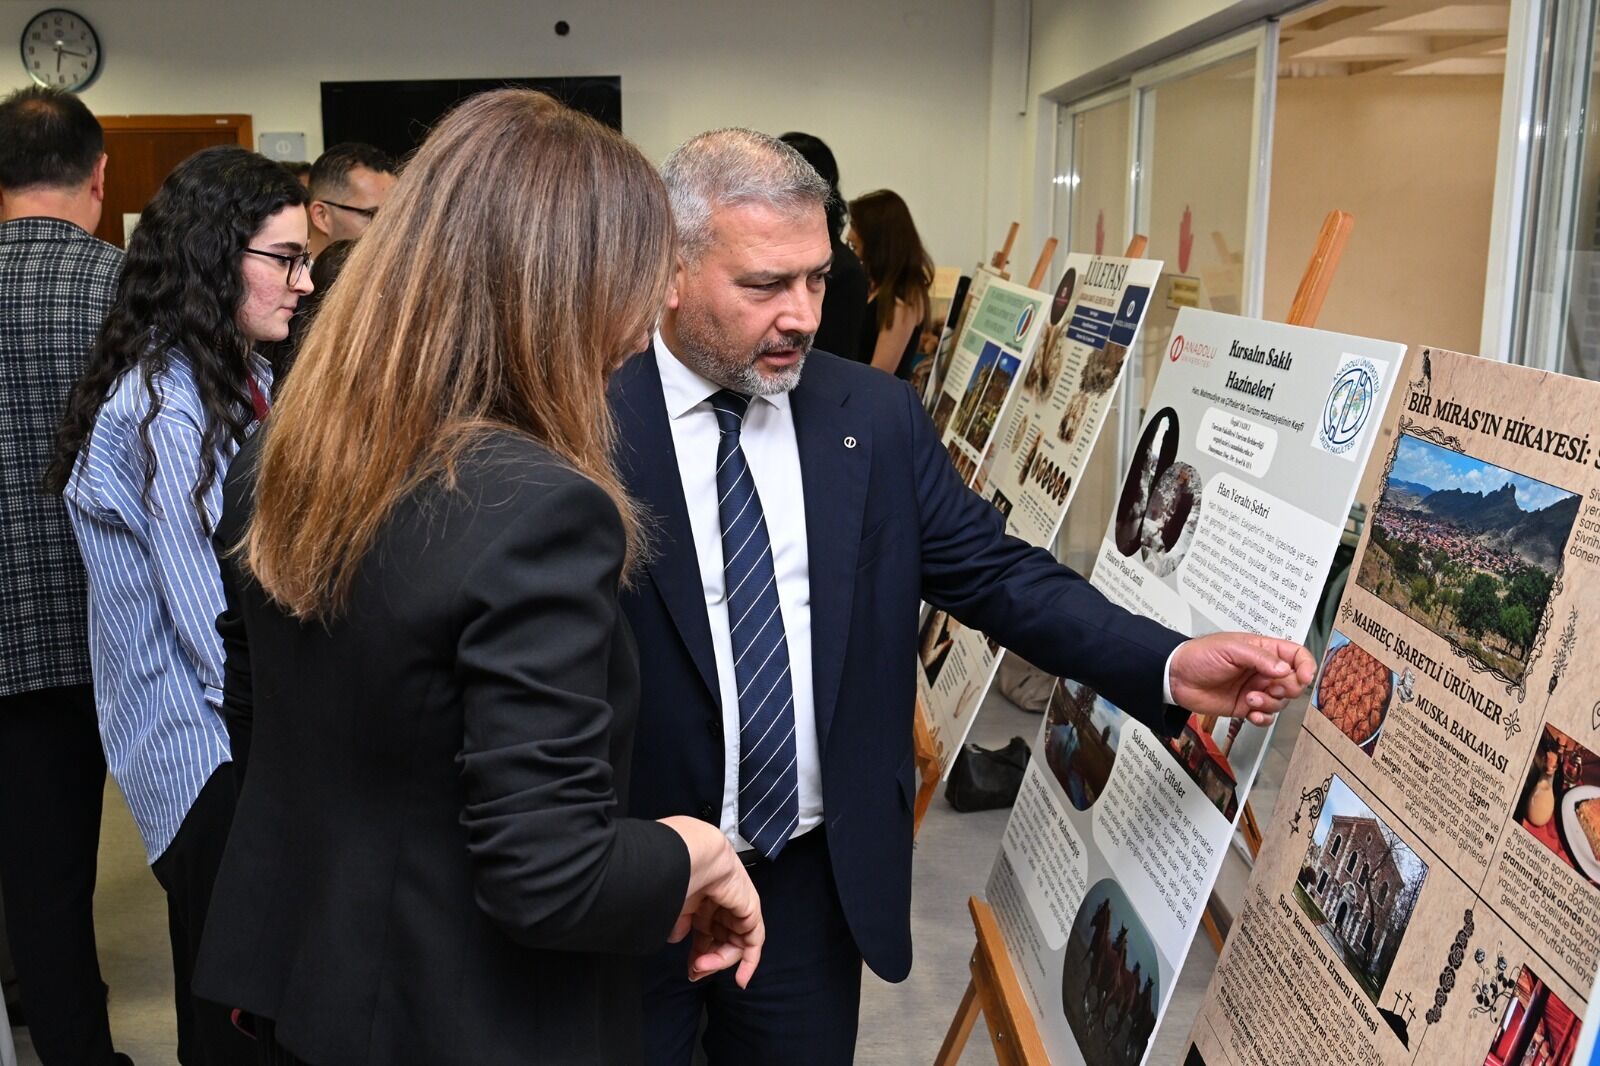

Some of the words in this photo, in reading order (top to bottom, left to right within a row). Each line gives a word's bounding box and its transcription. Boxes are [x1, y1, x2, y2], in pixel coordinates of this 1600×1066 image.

[1226, 371, 1275, 400] Hazineleri
[1229, 340, 1265, 364] Kırsalın
[1266, 348, 1292, 370] Saklı
[1408, 390, 1432, 416] BİR
[1433, 397, 1502, 436] MİRAS'IN
[1502, 417, 1591, 464] HİKAYESİ:
[1217, 482, 1230, 498] Han
[1231, 489, 1251, 509] Yeraltı
[1251, 500, 1270, 518] Şehri
[1282, 578, 1297, 590] edilen
[1300, 588, 1307, 598] bu
[1296, 552, 1306, 560] yer
[1306, 556, 1318, 567] alan
[1305, 573, 1313, 582] bir
[1279, 612, 1285, 620] ve
[1284, 599, 1302, 611] yaşam
[1352, 609, 1394, 651] MAHREÇ
[1393, 634, 1443, 682] İŞARETLİ
[1443, 668, 1502, 724] ÜRÜNLER
[1132, 729, 1162, 771] Sakaryabaşı
[1164, 768, 1185, 798] Çifteler
[1416, 694, 1448, 729] MUSKA
[1450, 720, 1508, 773] BAKLAVASI
[1420, 721, 1439, 741] Muska
[1440, 736, 1469, 765] Baklavası,
[1469, 761, 1505, 794] Eskişehir'in
[1381, 753, 1401, 775] belirgin
[1424, 791, 1458, 827] Sivrihisar'da
[1459, 822, 1483, 848] özellikle
[1395, 728, 1423, 754] geleneksel
[1423, 750, 1431, 761] bir
[1432, 757, 1450, 778] tatlıdır.
[1469, 787, 1489, 810] üçgen
[1402, 760, 1413, 772] onu
[1413, 768, 1429, 786] klasik
[1429, 782, 1463, 817] baklavadan
[1464, 814, 1484, 835] ayıran
[1485, 832, 1494, 844] en
[1408, 750, 1432, 773] "muska"
[1431, 773, 1478, 815] görünümünden
[1479, 812, 1490, 824] alır
[1491, 822, 1499, 833] ve
[1448, 759, 1470, 780] coğrafi
[1470, 777, 1488, 795] işaret
[1489, 792, 1507, 813] almış
[1405, 802, 1419, 819] sıkça
[1419, 815, 1437, 837] yapılır.
[1406, 790, 1437, 822] düğünlerde
[1438, 818, 1445, 829] ve
[1446, 825, 1459, 840] özel
[1458, 838, 1487, 867] günlerde
[1503, 852, 1532, 882] oranının
[1533, 877, 1556, 902] düşük
[1557, 899, 1584, 927] olması
[1506, 837, 1515, 851] Bu
[1516, 848, 1525, 860] da
[1526, 855, 1548, 880] tatlıya
[1549, 874, 1567, 896] hem
[1568, 890, 1590, 917] doğal
[1512, 828, 1550, 866] Pişirildikten
[1551, 863, 1573, 885] sonra
[1497, 876, 1519, 900] yapılır.
[1520, 895, 1530, 909] Bu
[1531, 906, 1560, 937] nedenle
[1561, 934, 1590, 965] sadece
[1499, 861, 1541, 903] Sivrihisar'da
[1541, 899, 1569, 929] özellikle
[1500, 892, 1538, 932] geleneksel
[1538, 929, 1565, 958] mutfak
[1264, 942, 1278, 966] Patrik
[1276, 962, 1296, 990] Nerses
[1291, 986, 1326, 1041] Varjabedyan
[1279, 894, 1294, 918] Surp
[1289, 912, 1332, 966] Yerortutyun
[1324, 960, 1354, 999] Ermeni
[1352, 993, 1379, 1035] Kilisesi
[1329, 989, 1343, 1009] alan
[1338, 1006, 1357, 1029] Surp
